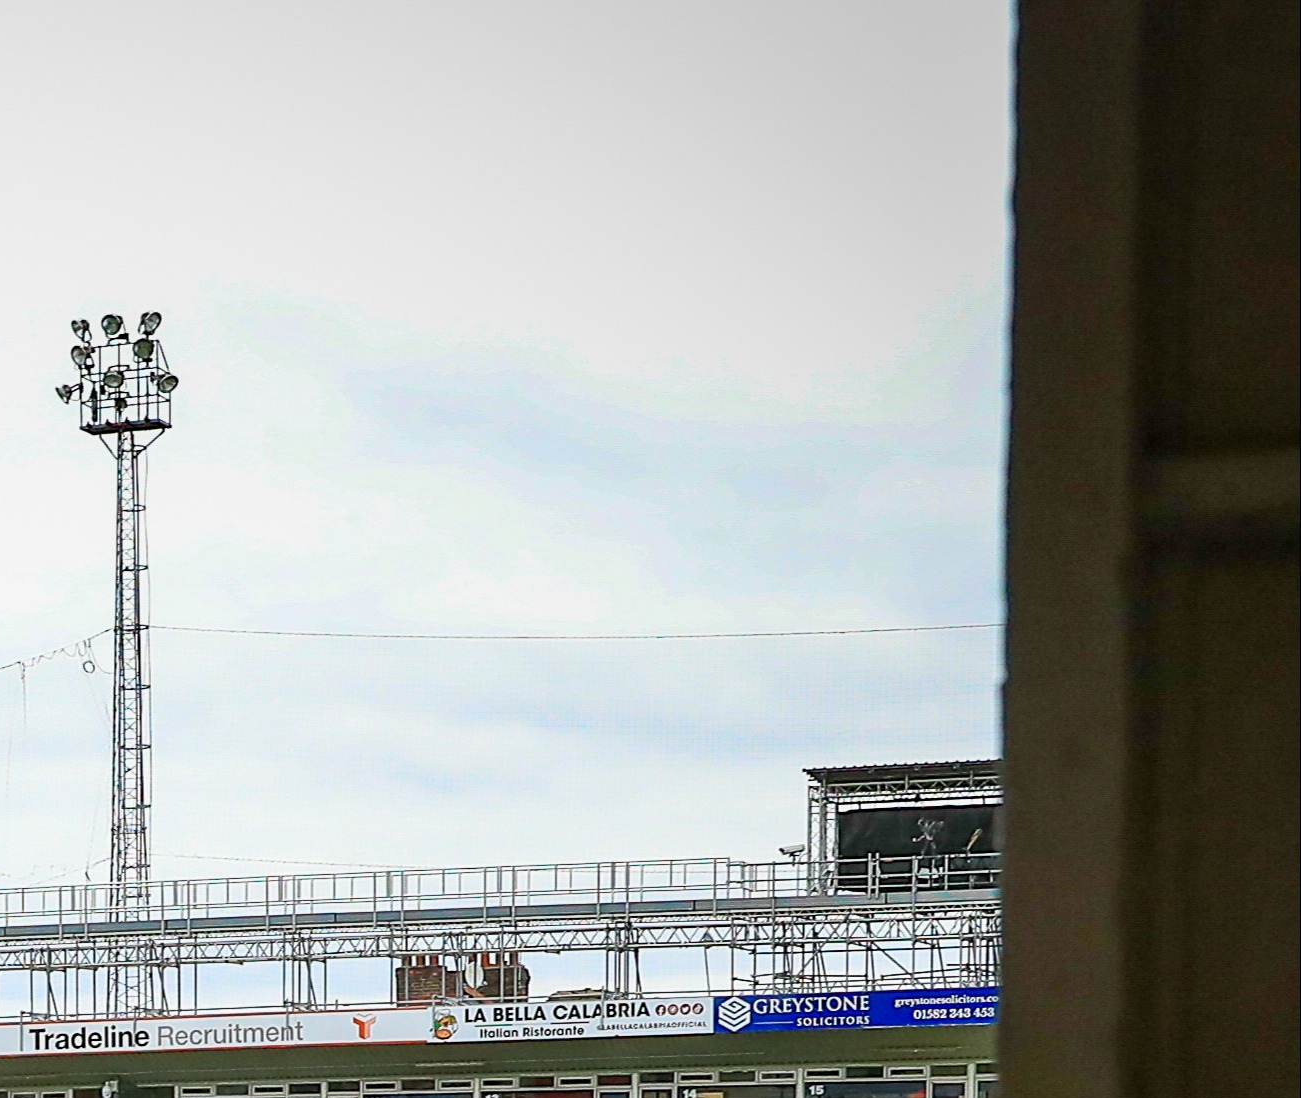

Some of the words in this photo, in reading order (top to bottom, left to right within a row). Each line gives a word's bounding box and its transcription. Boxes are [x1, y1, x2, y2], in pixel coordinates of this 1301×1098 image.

[753, 995, 870, 1014] GREYSTONE
[464, 1008, 486, 1023] LA
[493, 1006, 546, 1022] BELLA
[553, 1002, 649, 1020] CALABRIA
[797, 1015, 871, 1027] SOLICITORS
[29, 1027, 150, 1051] Tradeline
[157, 1021, 304, 1046] Recruitment
[480, 1026, 519, 1039] Italian
[522, 1025, 585, 1037] Ristorante
[682, 1089, 697, 1098] 14
[809, 1085, 825, 1096] 15
